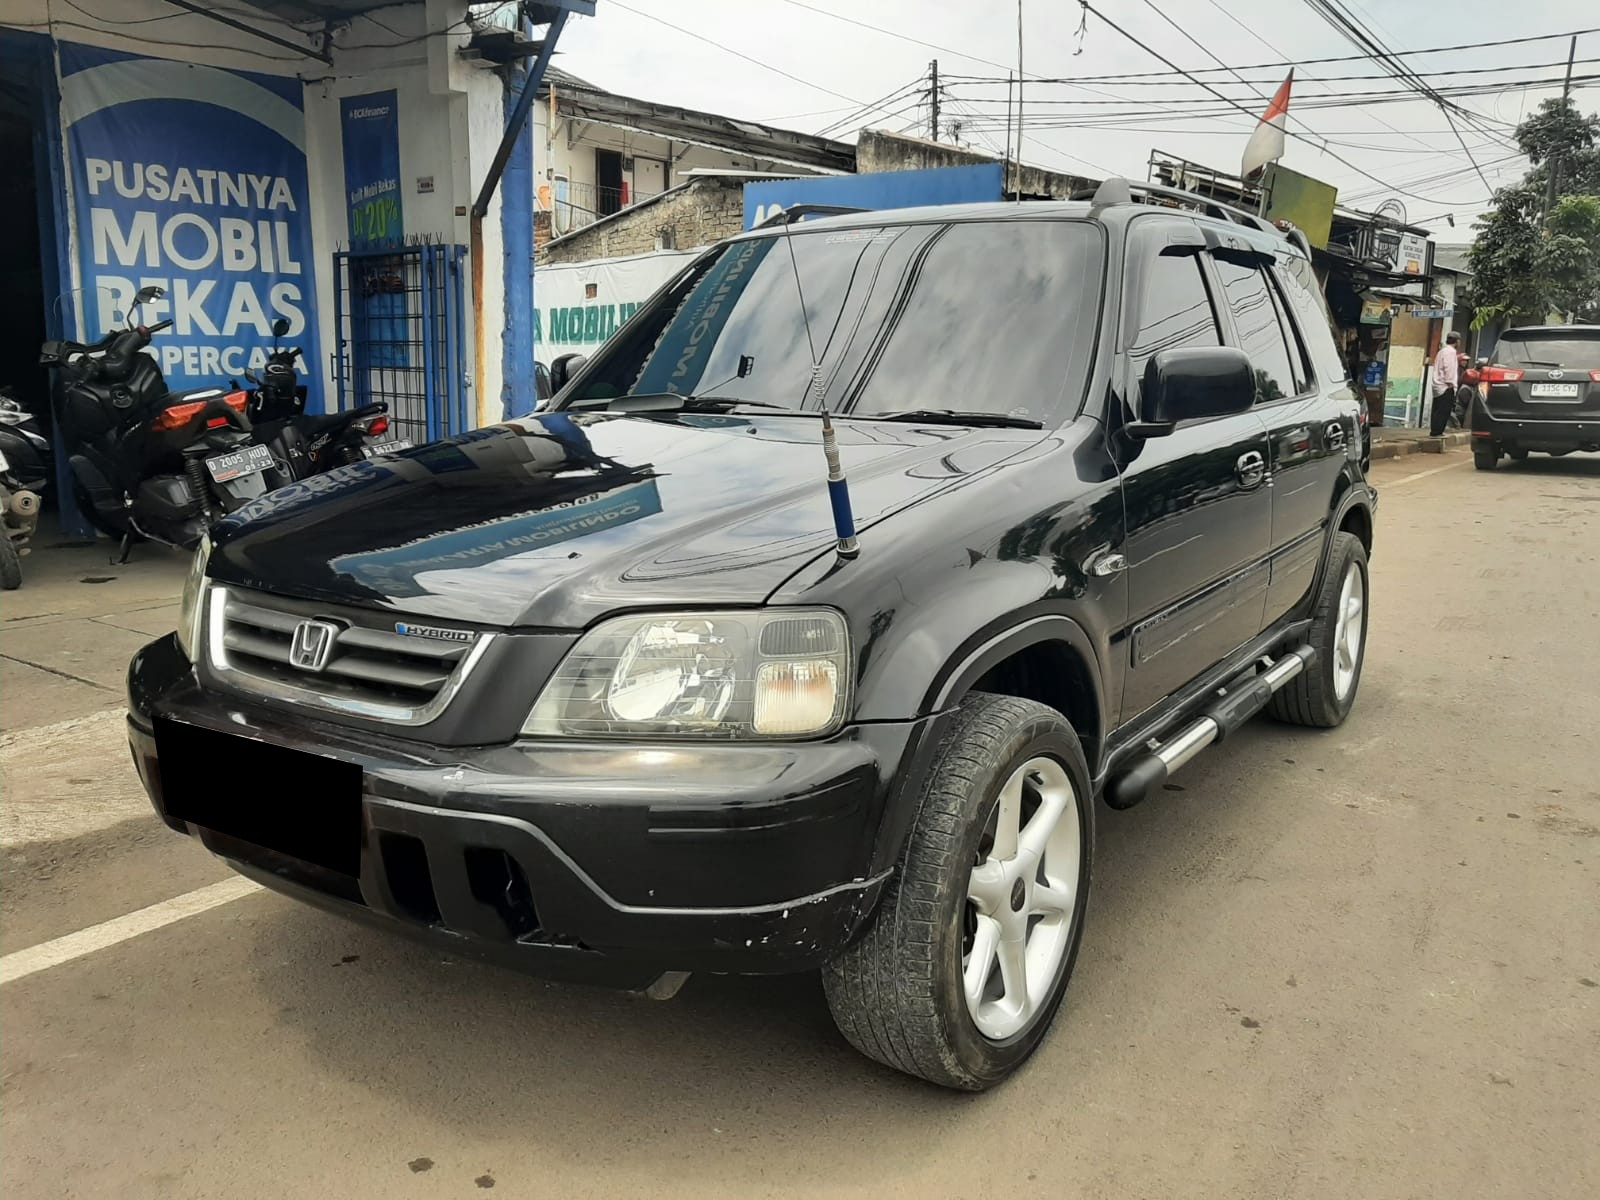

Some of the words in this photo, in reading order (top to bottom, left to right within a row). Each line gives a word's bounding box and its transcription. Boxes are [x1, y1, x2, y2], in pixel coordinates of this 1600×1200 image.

[86, 158, 297, 212] PUSATNYA
[91, 207, 302, 275] MOBIL
[96, 275, 306, 338] BEKAS
[219, 453, 244, 468] 2005
[248, 446, 267, 460] HUD
[407, 626, 469, 641] HYBRID
